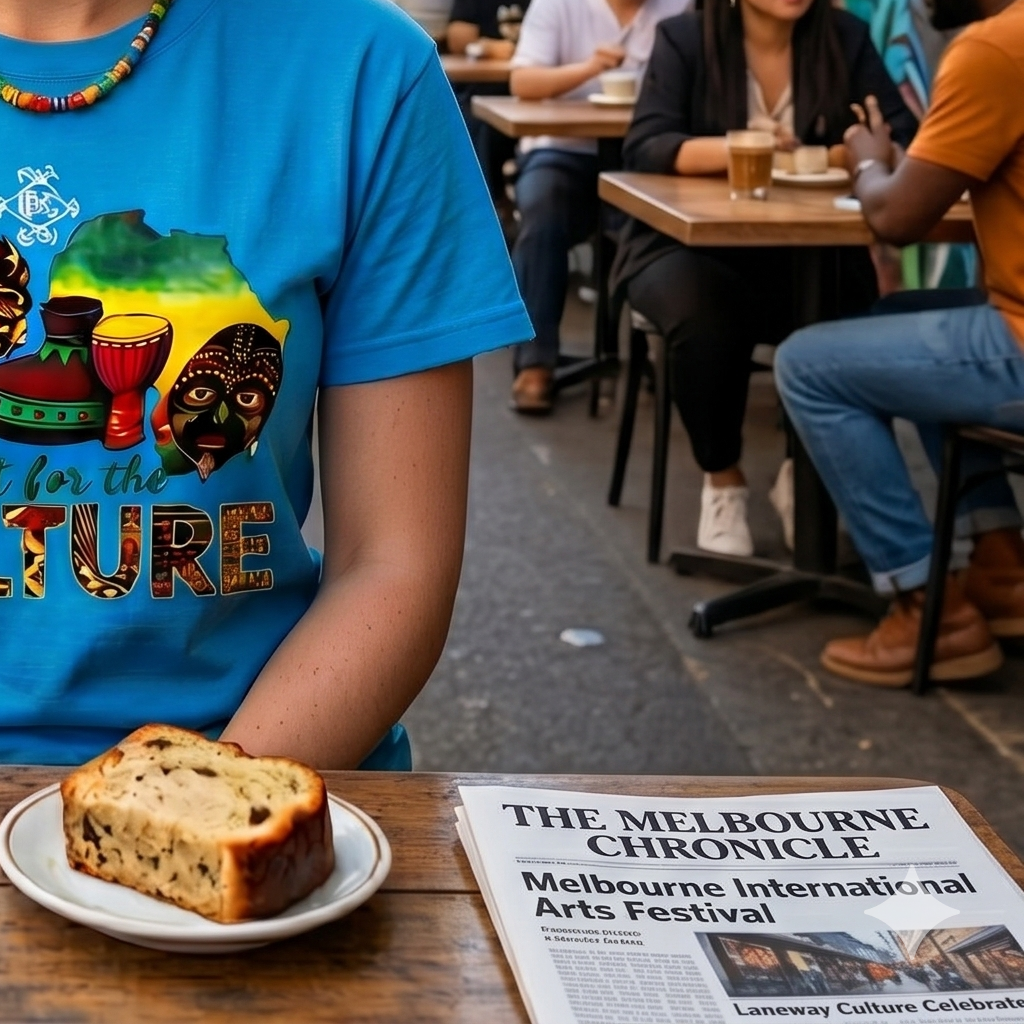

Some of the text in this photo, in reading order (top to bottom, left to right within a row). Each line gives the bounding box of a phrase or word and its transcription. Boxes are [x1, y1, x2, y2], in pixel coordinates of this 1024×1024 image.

[23, 454, 93, 501] for
[99, 453, 169, 496] the
[502, 804, 930, 834] THE MELBOURNE
[586, 834, 881, 861] CHRONICLE
[521, 871, 978, 898] Melbourne International
[535, 896, 777, 924] Arts Festival
[733, 1002, 830, 1019] Laneway
[836, 1000, 918, 1015] Culture
